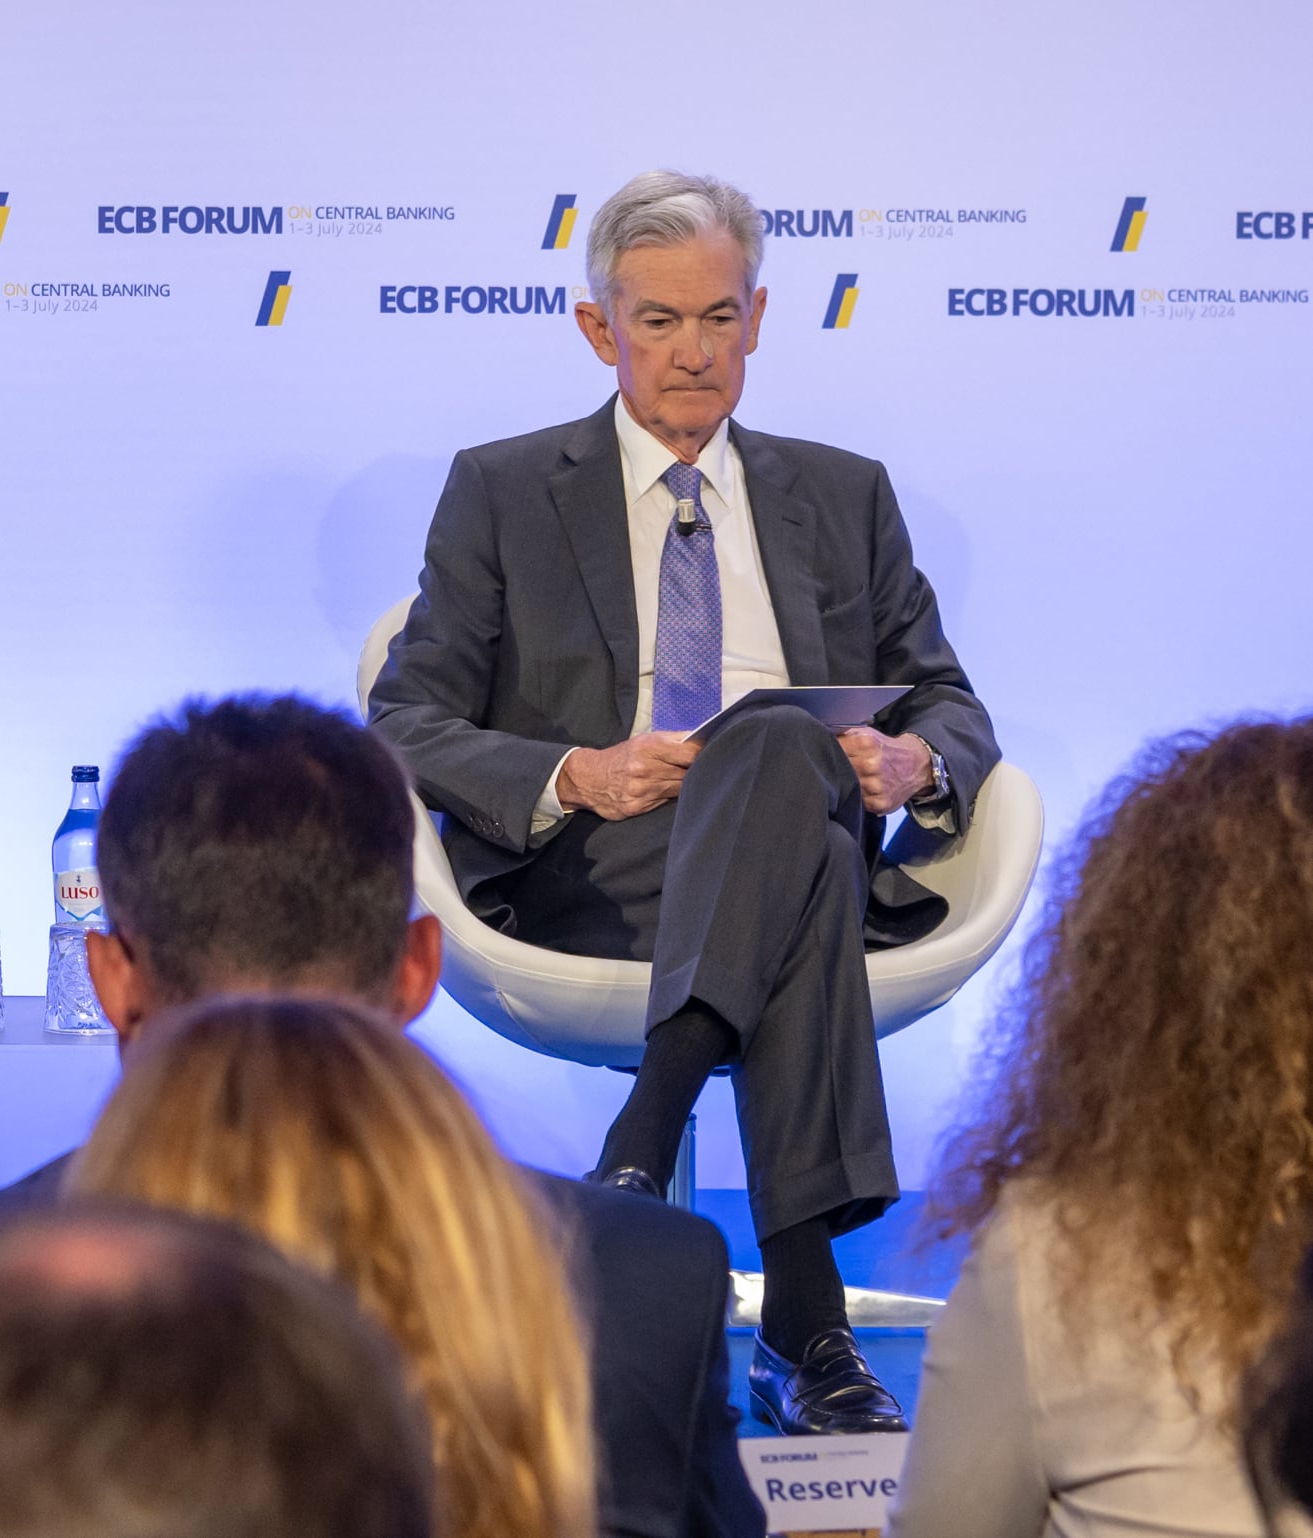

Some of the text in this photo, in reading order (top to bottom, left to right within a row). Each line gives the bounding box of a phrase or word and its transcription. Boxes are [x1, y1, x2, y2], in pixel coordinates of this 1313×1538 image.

[98, 206, 455, 234] ECB FORUM ON CENTRAL BANKING
[760, 209, 1026, 237] RUM ON CENTRAL BANKING
[1236, 211, 1295, 239] ECB
[317, 222, 343, 237] July
[347, 222, 382, 235] 2024
[888, 225, 913, 240] July
[919, 225, 953, 237] 2024
[4, 284, 27, 297] ON
[31, 284, 98, 297] CENTRAL
[102, 284, 170, 297] BANKING
[32, 299, 58, 315] July
[63, 299, 98, 312] 2024
[380, 285, 438, 313] ECB
[445, 286, 565, 314] FORUM
[948, 288, 1309, 317] ECB FORUM ON CENTRAL BANKING
[1170, 305, 1196, 320] July
[1201, 305, 1235, 318] 2024
[61, 886, 99, 899] LUSO
